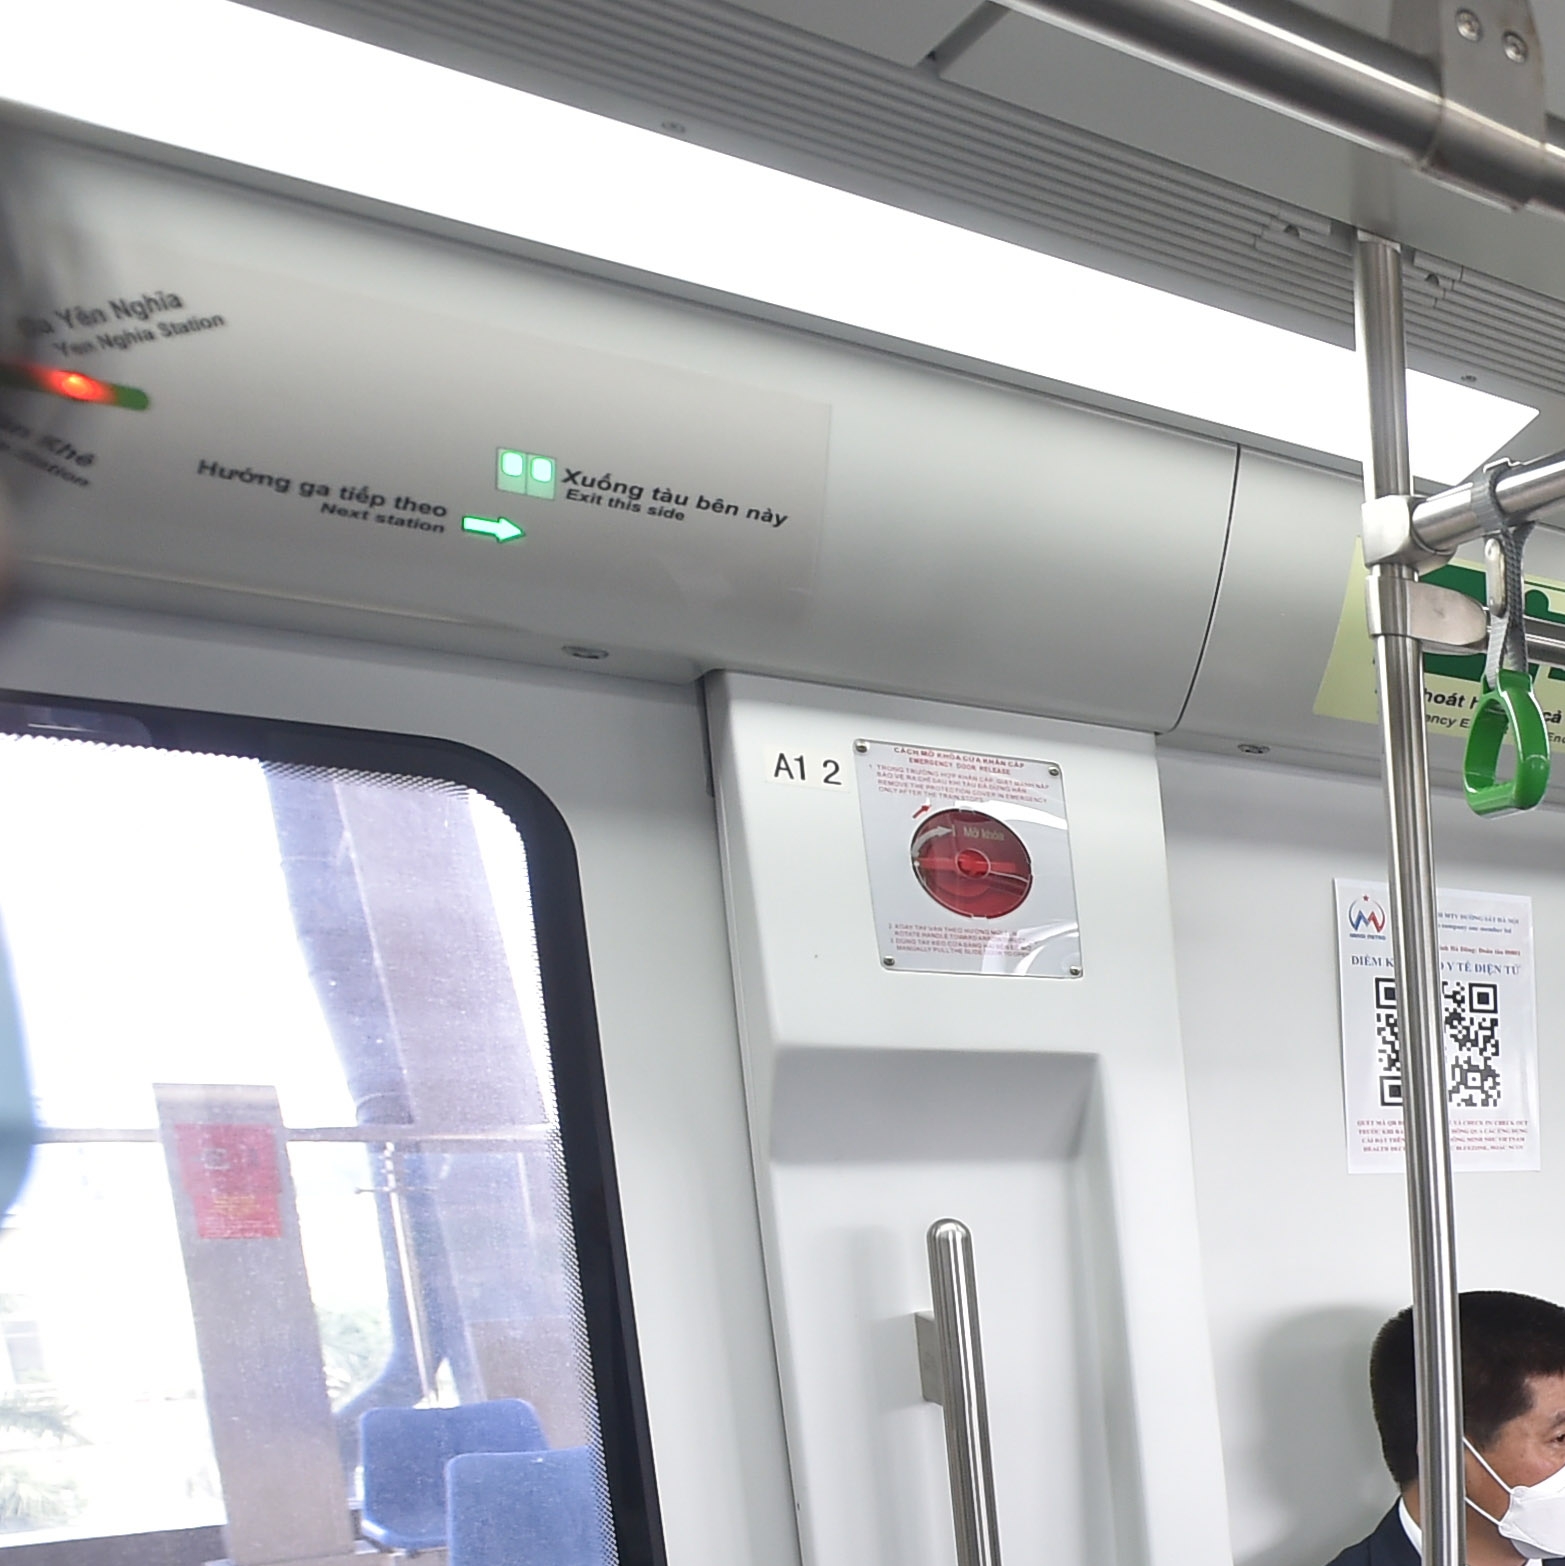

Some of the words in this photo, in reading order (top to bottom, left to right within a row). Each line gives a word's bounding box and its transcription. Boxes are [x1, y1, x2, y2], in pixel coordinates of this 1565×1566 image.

[110, 291, 183, 320] Nghĩa
[97, 327, 156, 350] Nghia
[157, 313, 226, 338] Station
[197, 459, 291, 494] Hướng
[299, 480, 331, 498] ga
[339, 485, 386, 509] tiếp
[393, 495, 448, 518] theo
[562, 468, 644, 500] Xuống
[652, 487, 689, 507] tàu
[696, 494, 739, 517] bên
[746, 507, 788, 529] này
[320, 502, 371, 521] Next
[374, 512, 446, 534] station
[566, 489, 603, 506] Exit
[607, 496, 641, 513] this
[647, 504, 686, 522] side
[1424, 687, 1466, 708] hoát
[773, 752, 807, 782] A1
[822, 760, 842, 785] 2
